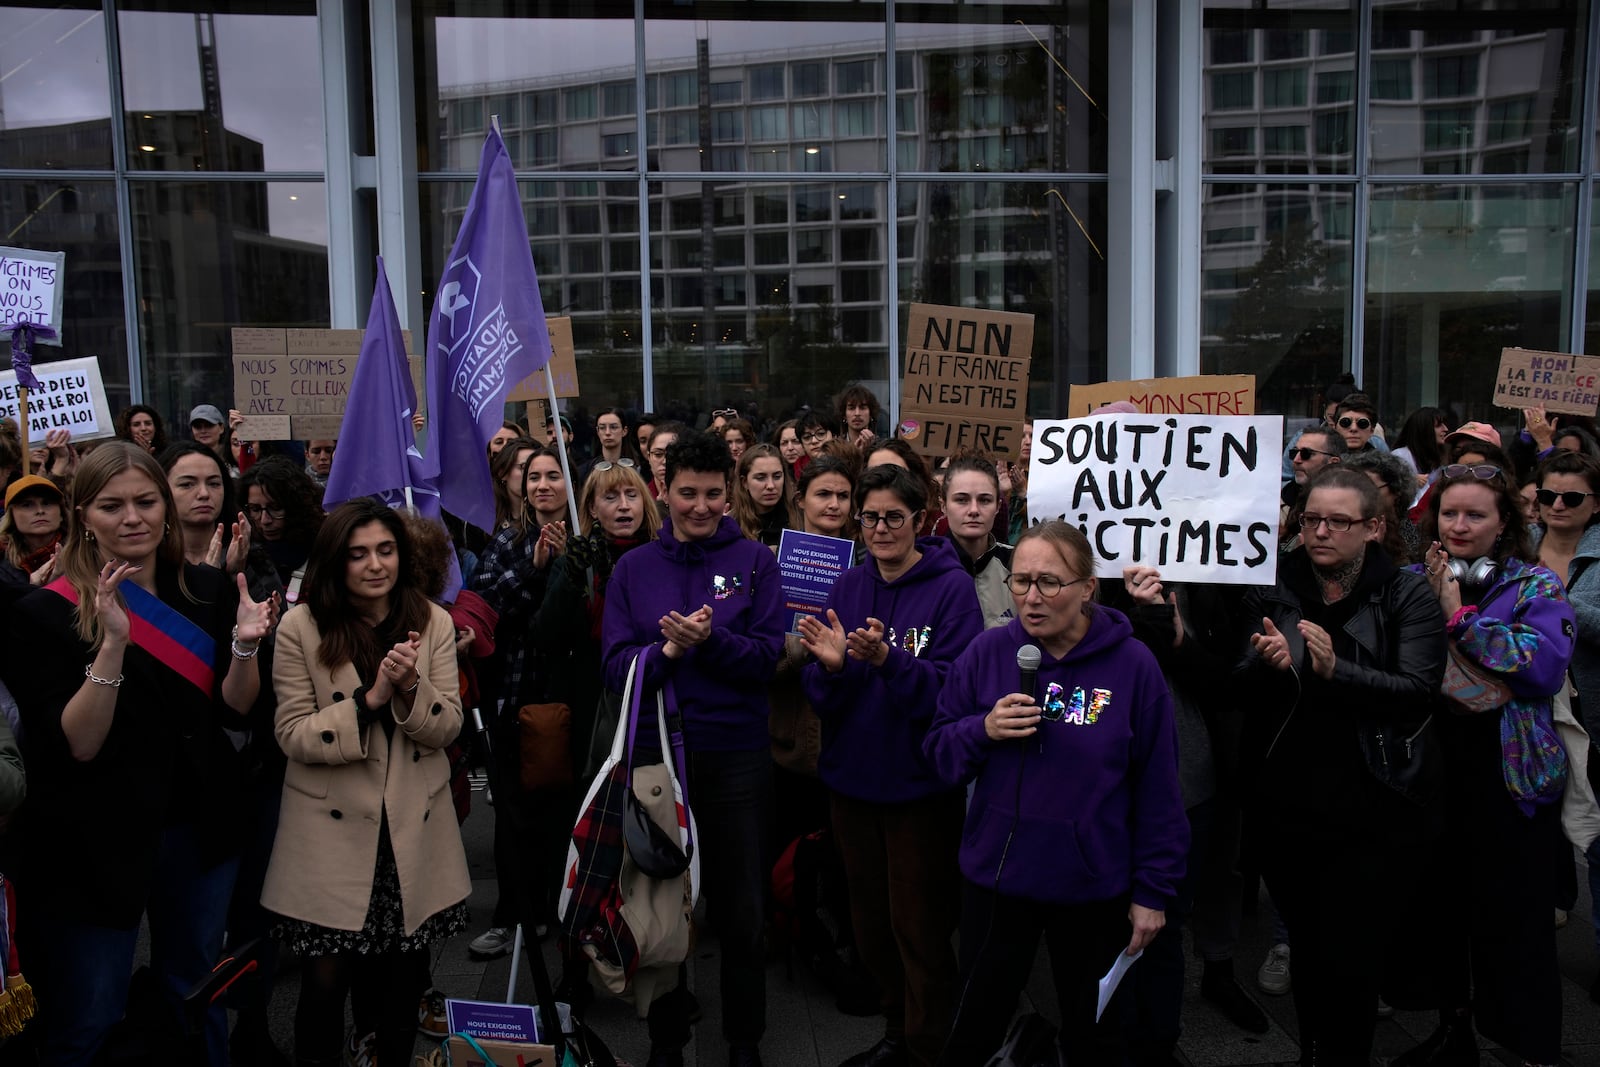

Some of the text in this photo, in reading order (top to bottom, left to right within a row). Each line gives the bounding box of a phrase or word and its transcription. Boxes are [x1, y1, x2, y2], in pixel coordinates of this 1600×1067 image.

[8, 277, 31, 291] ON
[923, 317, 1012, 357] NON
[241, 359, 347, 375] NOUS SOMMES
[908, 352, 1022, 381] LA FRANCE
[1507, 368, 1596, 388] LA FRANCE
[251, 380, 348, 396] DE CELLEUX
[917, 383, 1017, 409] N'EST PAS
[1497, 380, 1531, 398] N'EST
[1534, 387, 1558, 401] PAS
[48, 395, 64, 410] LE
[66, 391, 89, 406] ROI
[248, 398, 286, 413] AVEZ
[1129, 389, 1249, 416] MONSTRE
[51, 413, 71, 427] LA
[72, 409, 93, 424] LOI
[1072, 468, 1167, 511] AUX
[787, 555, 800, 563] UNE
[793, 548, 839, 561] NOUS EXIGEONS
[780, 562, 804, 571] CONTRE
[781, 570, 805, 580] SEXISTES
[1044, 682, 1112, 725] BAF
[487, 1022, 521, 1031] EXIGEONS
